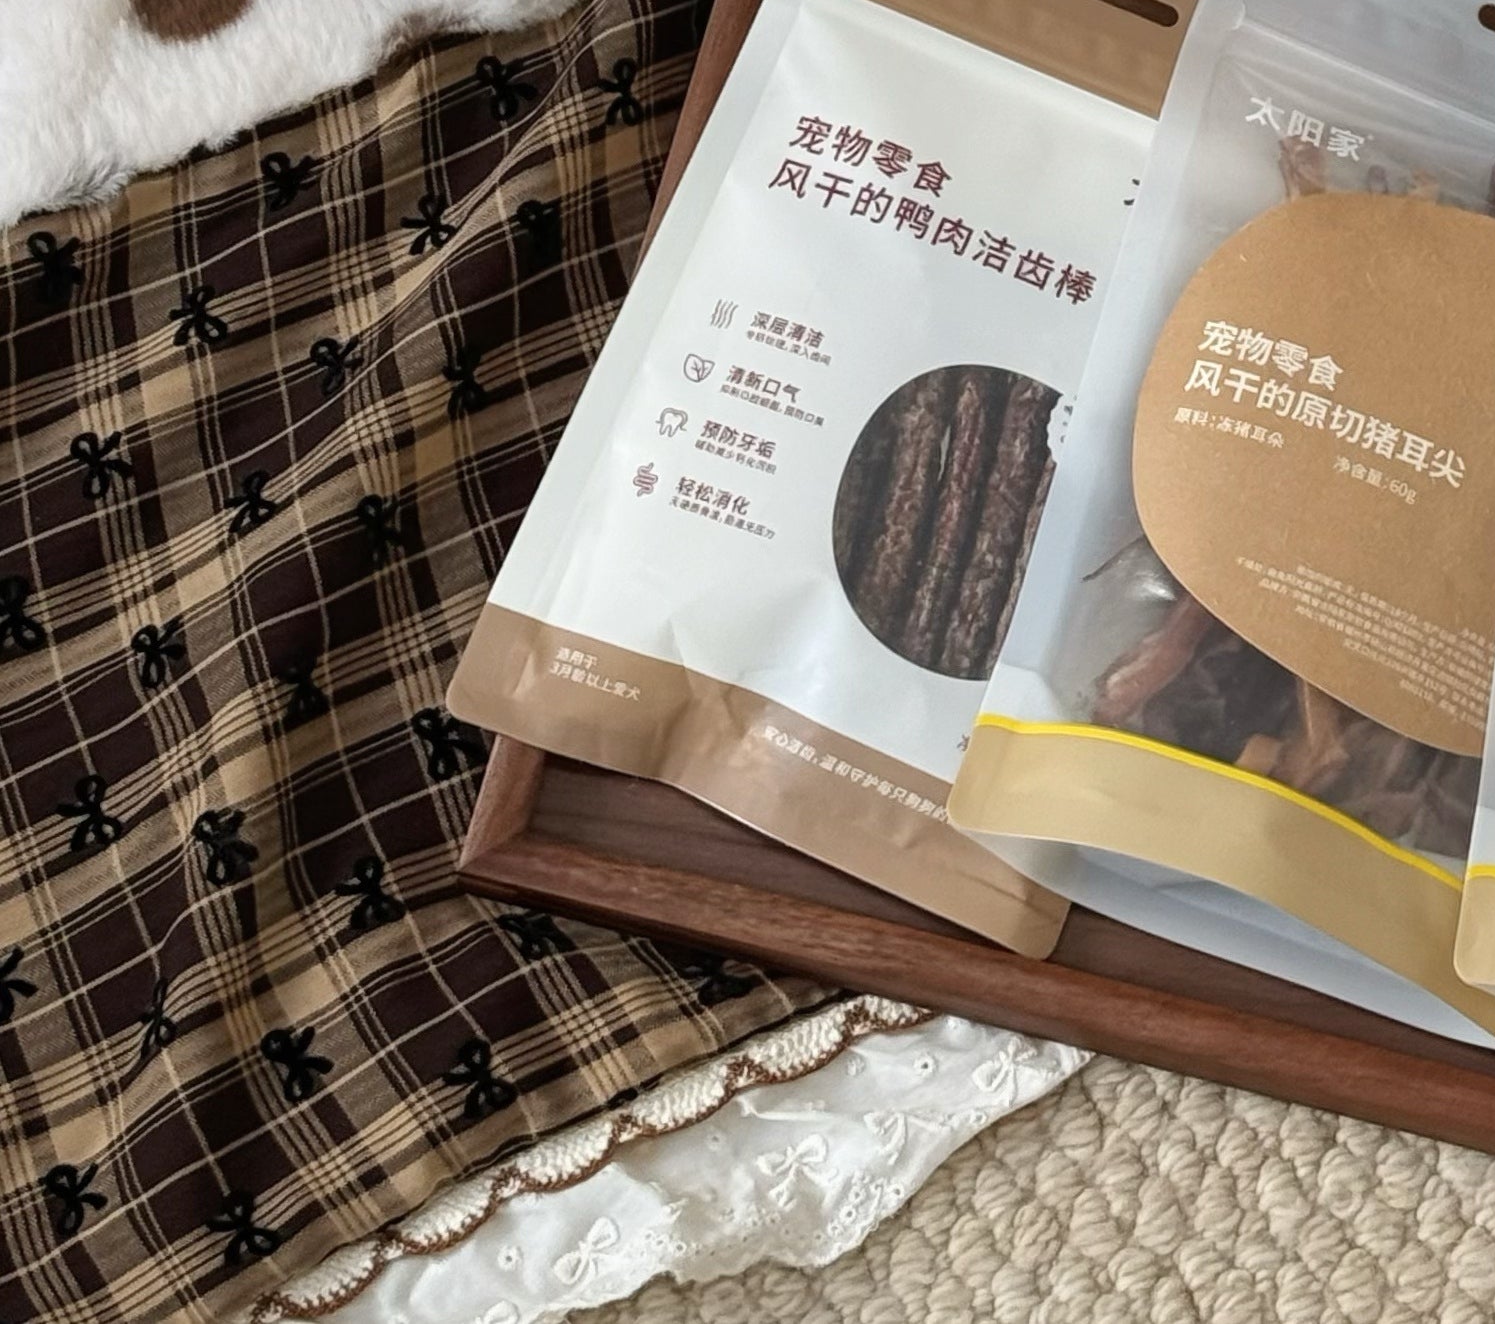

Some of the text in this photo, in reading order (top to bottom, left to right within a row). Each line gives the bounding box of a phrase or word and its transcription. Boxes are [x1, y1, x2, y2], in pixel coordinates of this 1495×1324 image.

[789, 114, 953, 198] 宠物零食
[1244, 95, 1368, 162] 太阳家
[769, 158, 1098, 306] 风干的鸭肉洁齿棒
[750, 311, 825, 348] 深层清洁
[1198, 320, 1344, 391] 宠物零食
[729, 365, 801, 403] 清新口气
[700, 420, 777, 459] 预防牙垢
[1184, 359, 1467, 488] 风干的原切猪耳尖
[678, 476, 751, 516] 轻松消化
